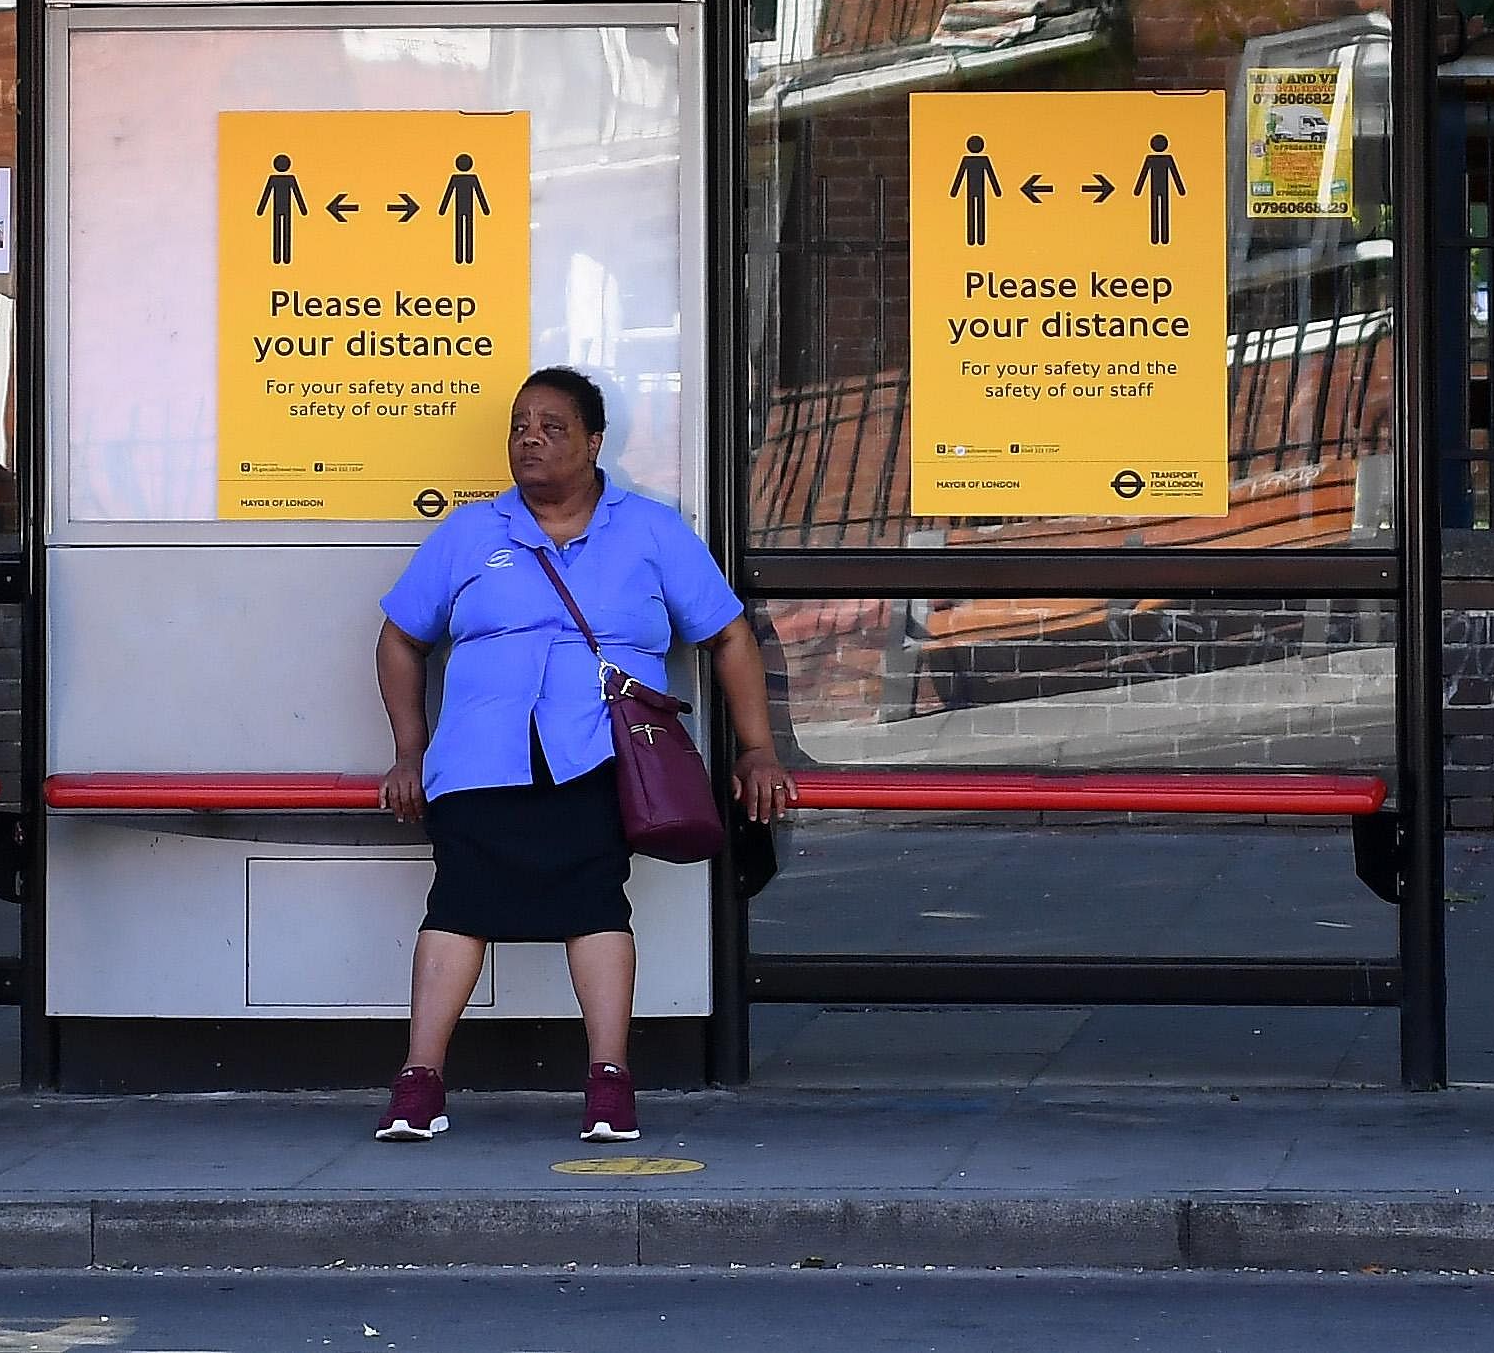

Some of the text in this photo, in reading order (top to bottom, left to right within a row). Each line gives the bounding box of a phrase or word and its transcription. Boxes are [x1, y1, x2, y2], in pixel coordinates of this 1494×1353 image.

[1287, 74, 1317, 84] AND
[1253, 203, 1348, 213] 0796066829
[967, 272, 1171, 304] Please keep
[272, 291, 475, 323] Please keep
[948, 312, 1189, 344] your distance
[254, 331, 492, 362] your distance
[962, 361, 1176, 378] For your safety and the
[267, 380, 479, 397] For your safety and the
[986, 382, 1153, 400] safety of our staff
[290, 402, 456, 419] safety of our staff
[1151, 481, 1204, 489] FOR LONDON
[286, 497, 323, 506] LONDON
